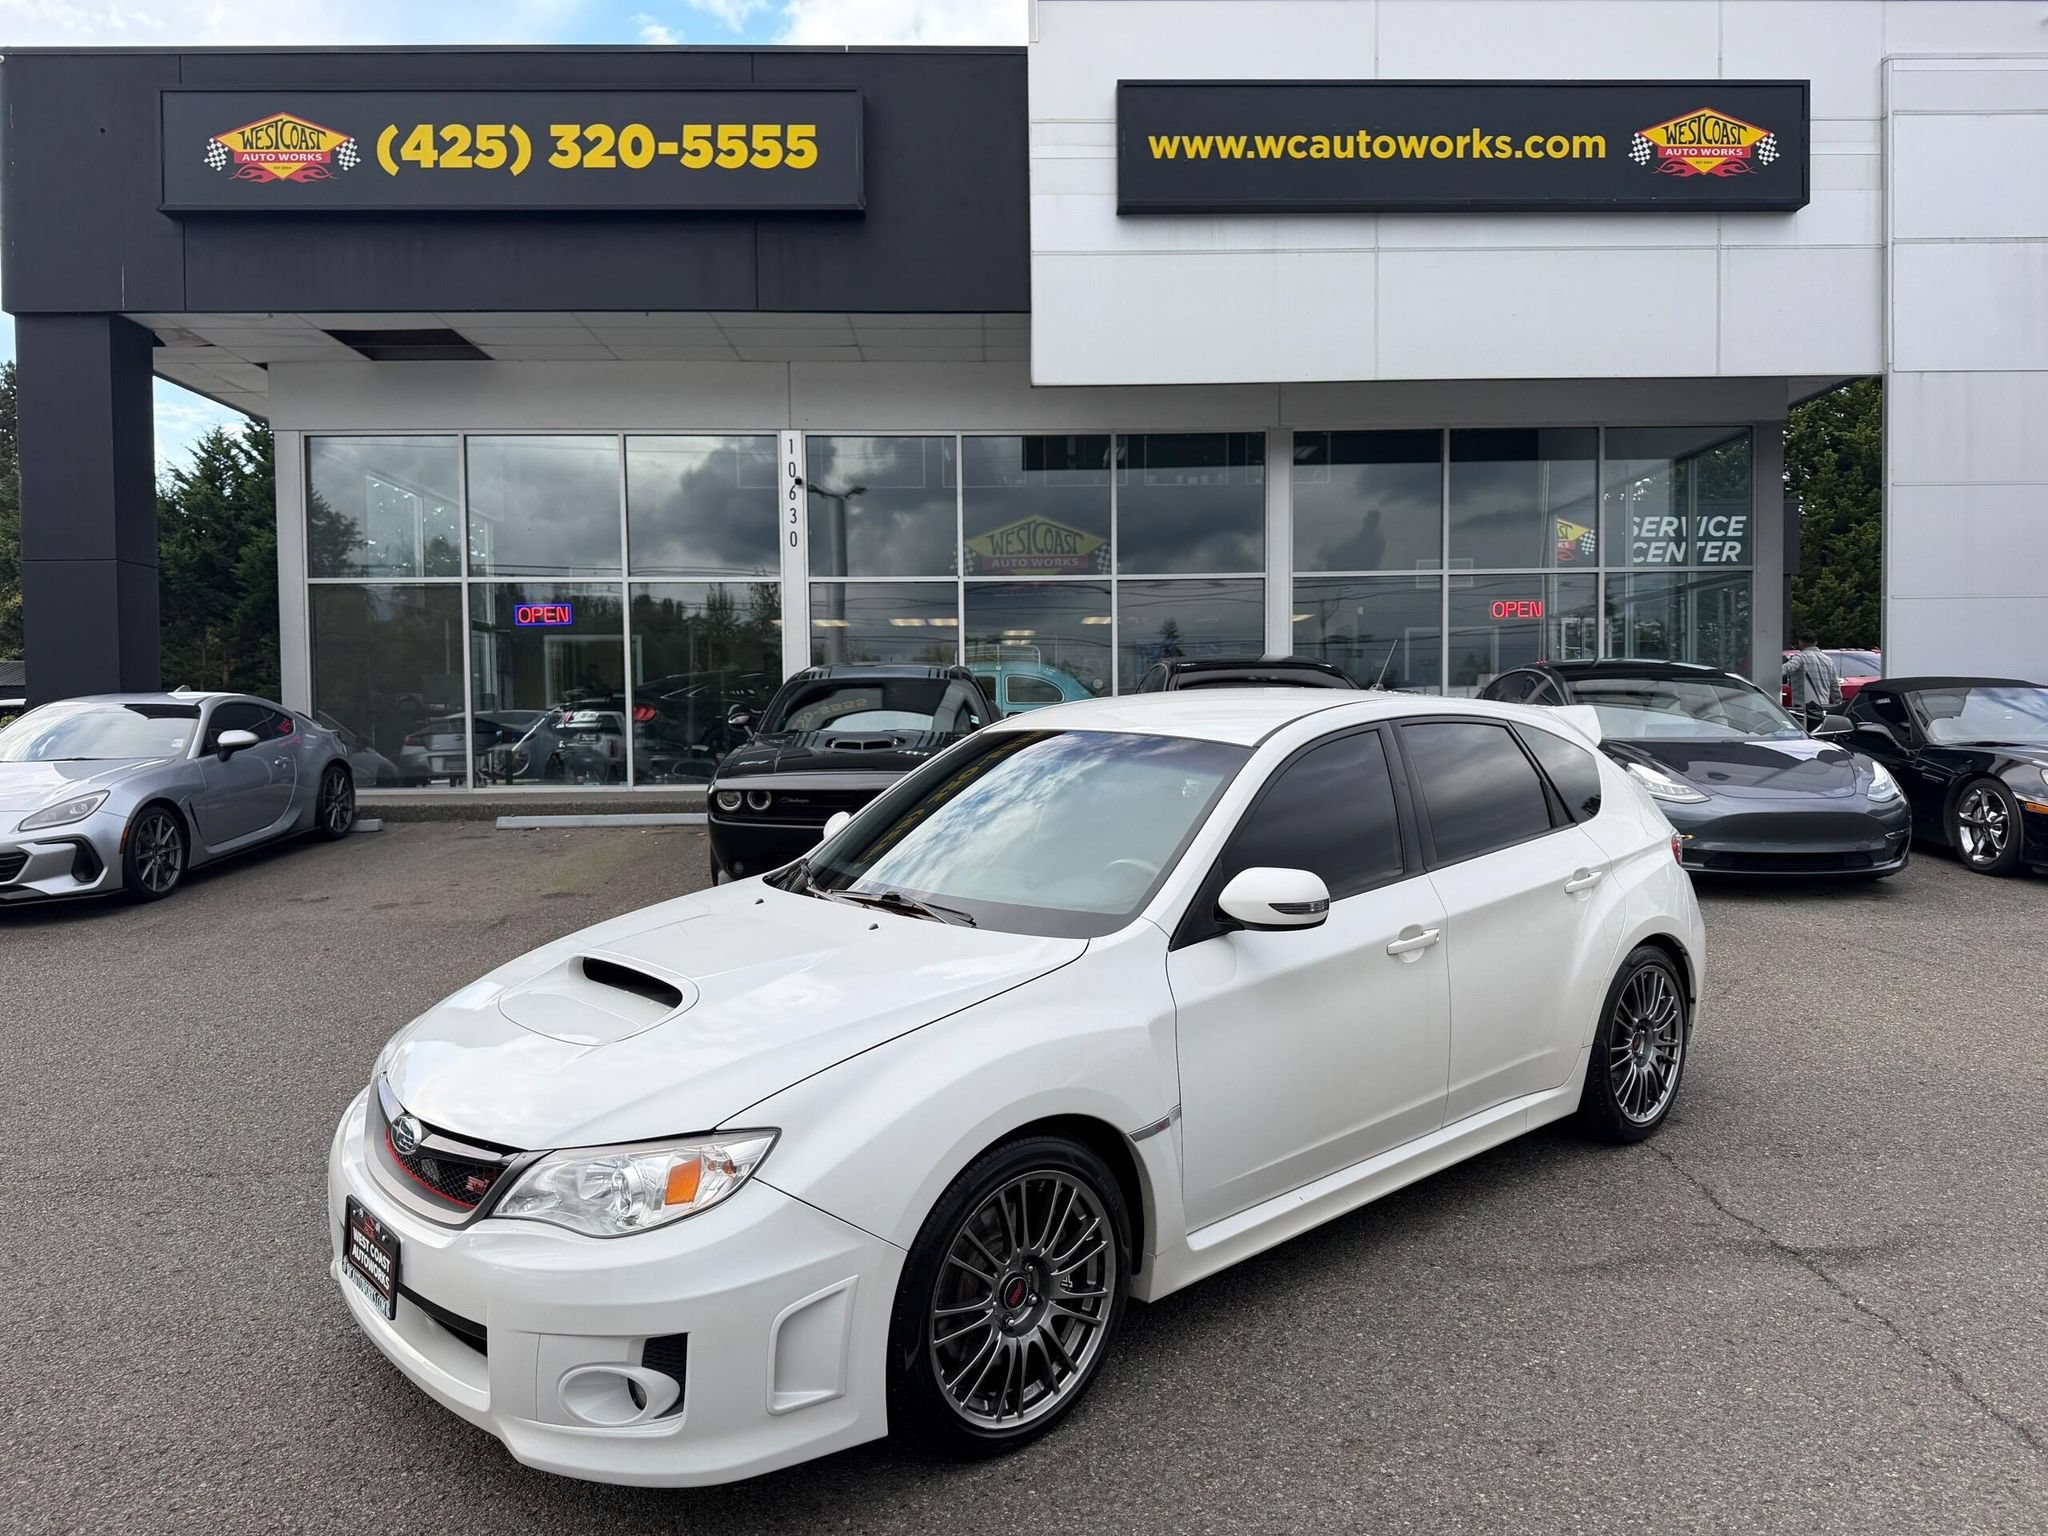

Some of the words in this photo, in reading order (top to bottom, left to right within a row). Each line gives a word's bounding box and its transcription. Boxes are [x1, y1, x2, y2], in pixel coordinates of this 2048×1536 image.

[376, 123, 532, 176] (425)
[547, 123, 819, 169] 320-5555
[1148, 127, 1607, 160] www.wcautoworks.com
[1665, 147, 1698, 156] AUTO
[1700, 147, 1743, 156] WORKS
[242, 152, 276, 161] AUTO
[279, 152, 323, 161] WORKS
[788, 438, 798, 548] 10630
[992, 557, 1027, 568] AUTO
[1030, 557, 1080, 567] WORKS
[518, 606, 569, 623] OPEN
[1492, 601, 1542, 618] OPEN
[352, 1226, 370, 1253] WEST
[370, 1243, 391, 1273] COAST
